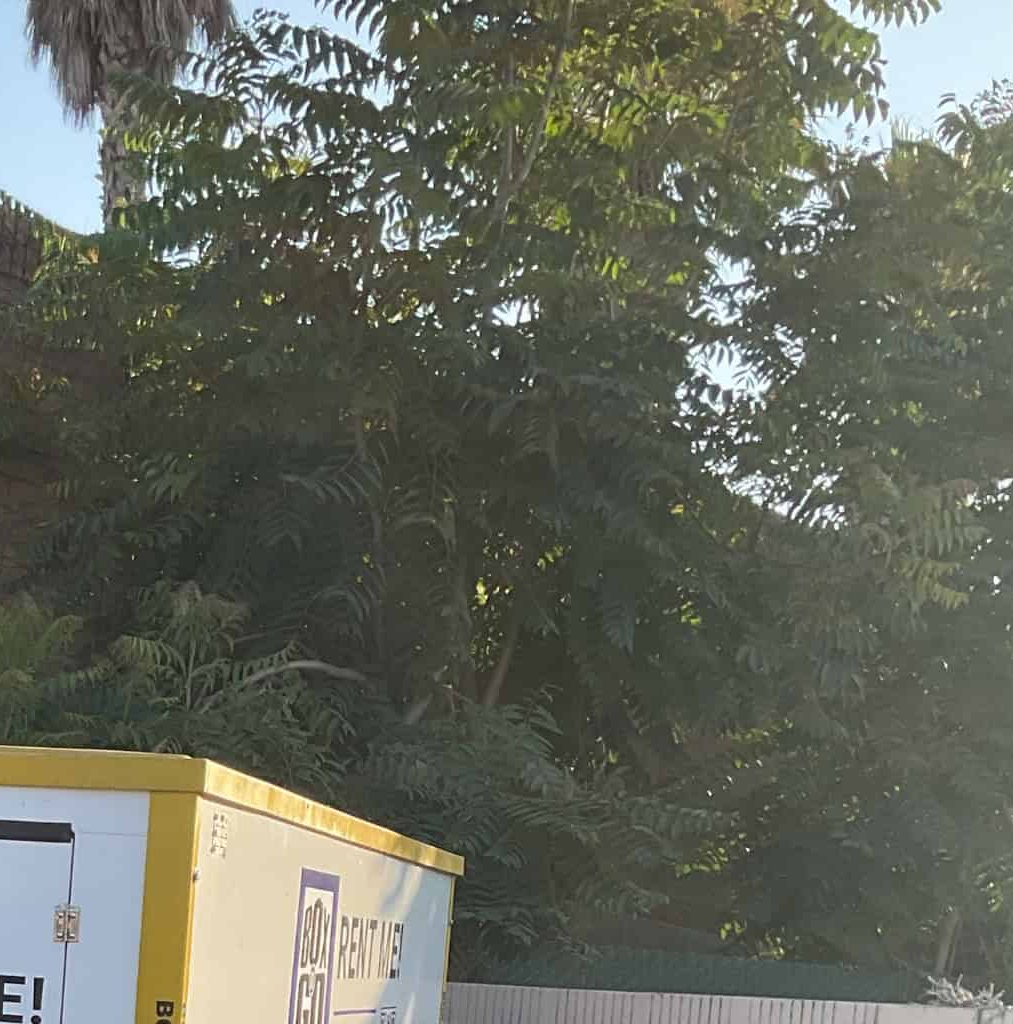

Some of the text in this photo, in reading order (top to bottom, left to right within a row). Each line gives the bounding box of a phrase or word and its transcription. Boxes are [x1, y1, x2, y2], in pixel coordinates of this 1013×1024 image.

[300, 897, 330, 969] BOX
[337, 915, 378, 980] RENT
[378, 919, 404, 981] ME!
